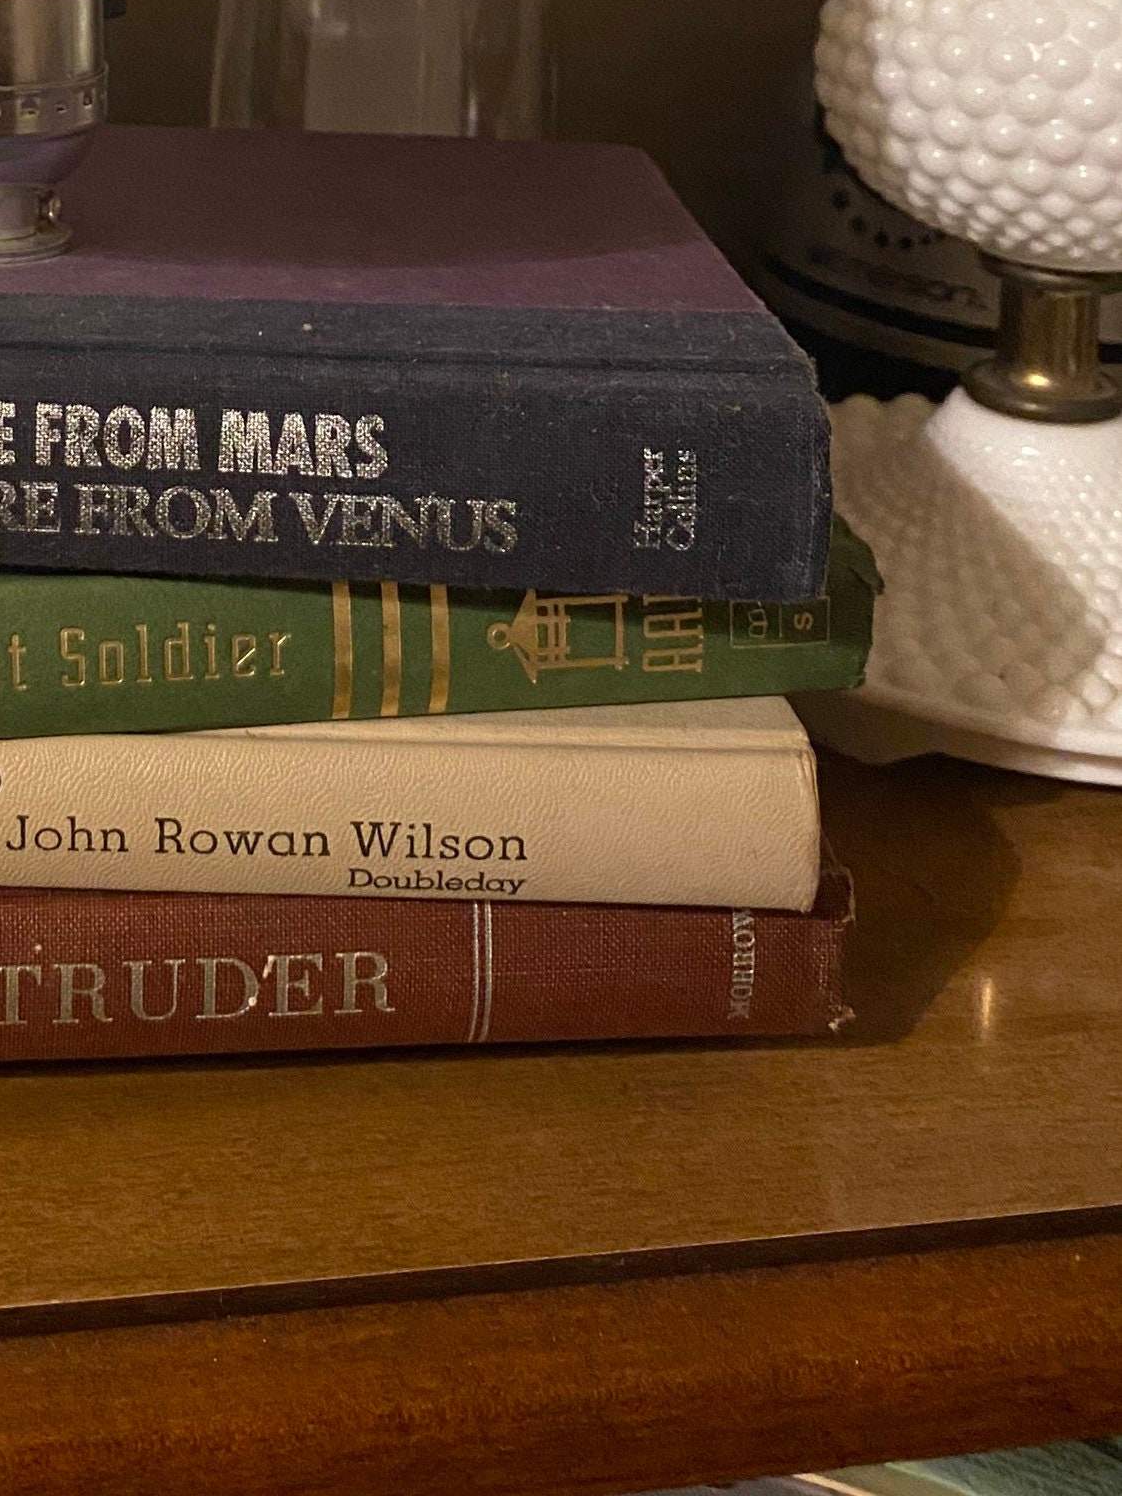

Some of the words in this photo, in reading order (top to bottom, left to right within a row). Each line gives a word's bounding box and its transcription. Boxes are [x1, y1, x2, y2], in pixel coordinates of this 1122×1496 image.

[35, 402, 200, 470] FROM
[219, 409, 389, 479] MARS
[72, 483, 278, 541] FROM
[289, 491, 518, 553] VENUS
[633, 448, 671, 550] Harper
[60, 621, 291, 688] Soldier
[6, 815, 129, 853] John
[154, 817, 331, 857] Rowan
[351, 821, 528, 862] Wilson
[348, 868, 526, 894] Doubleday
